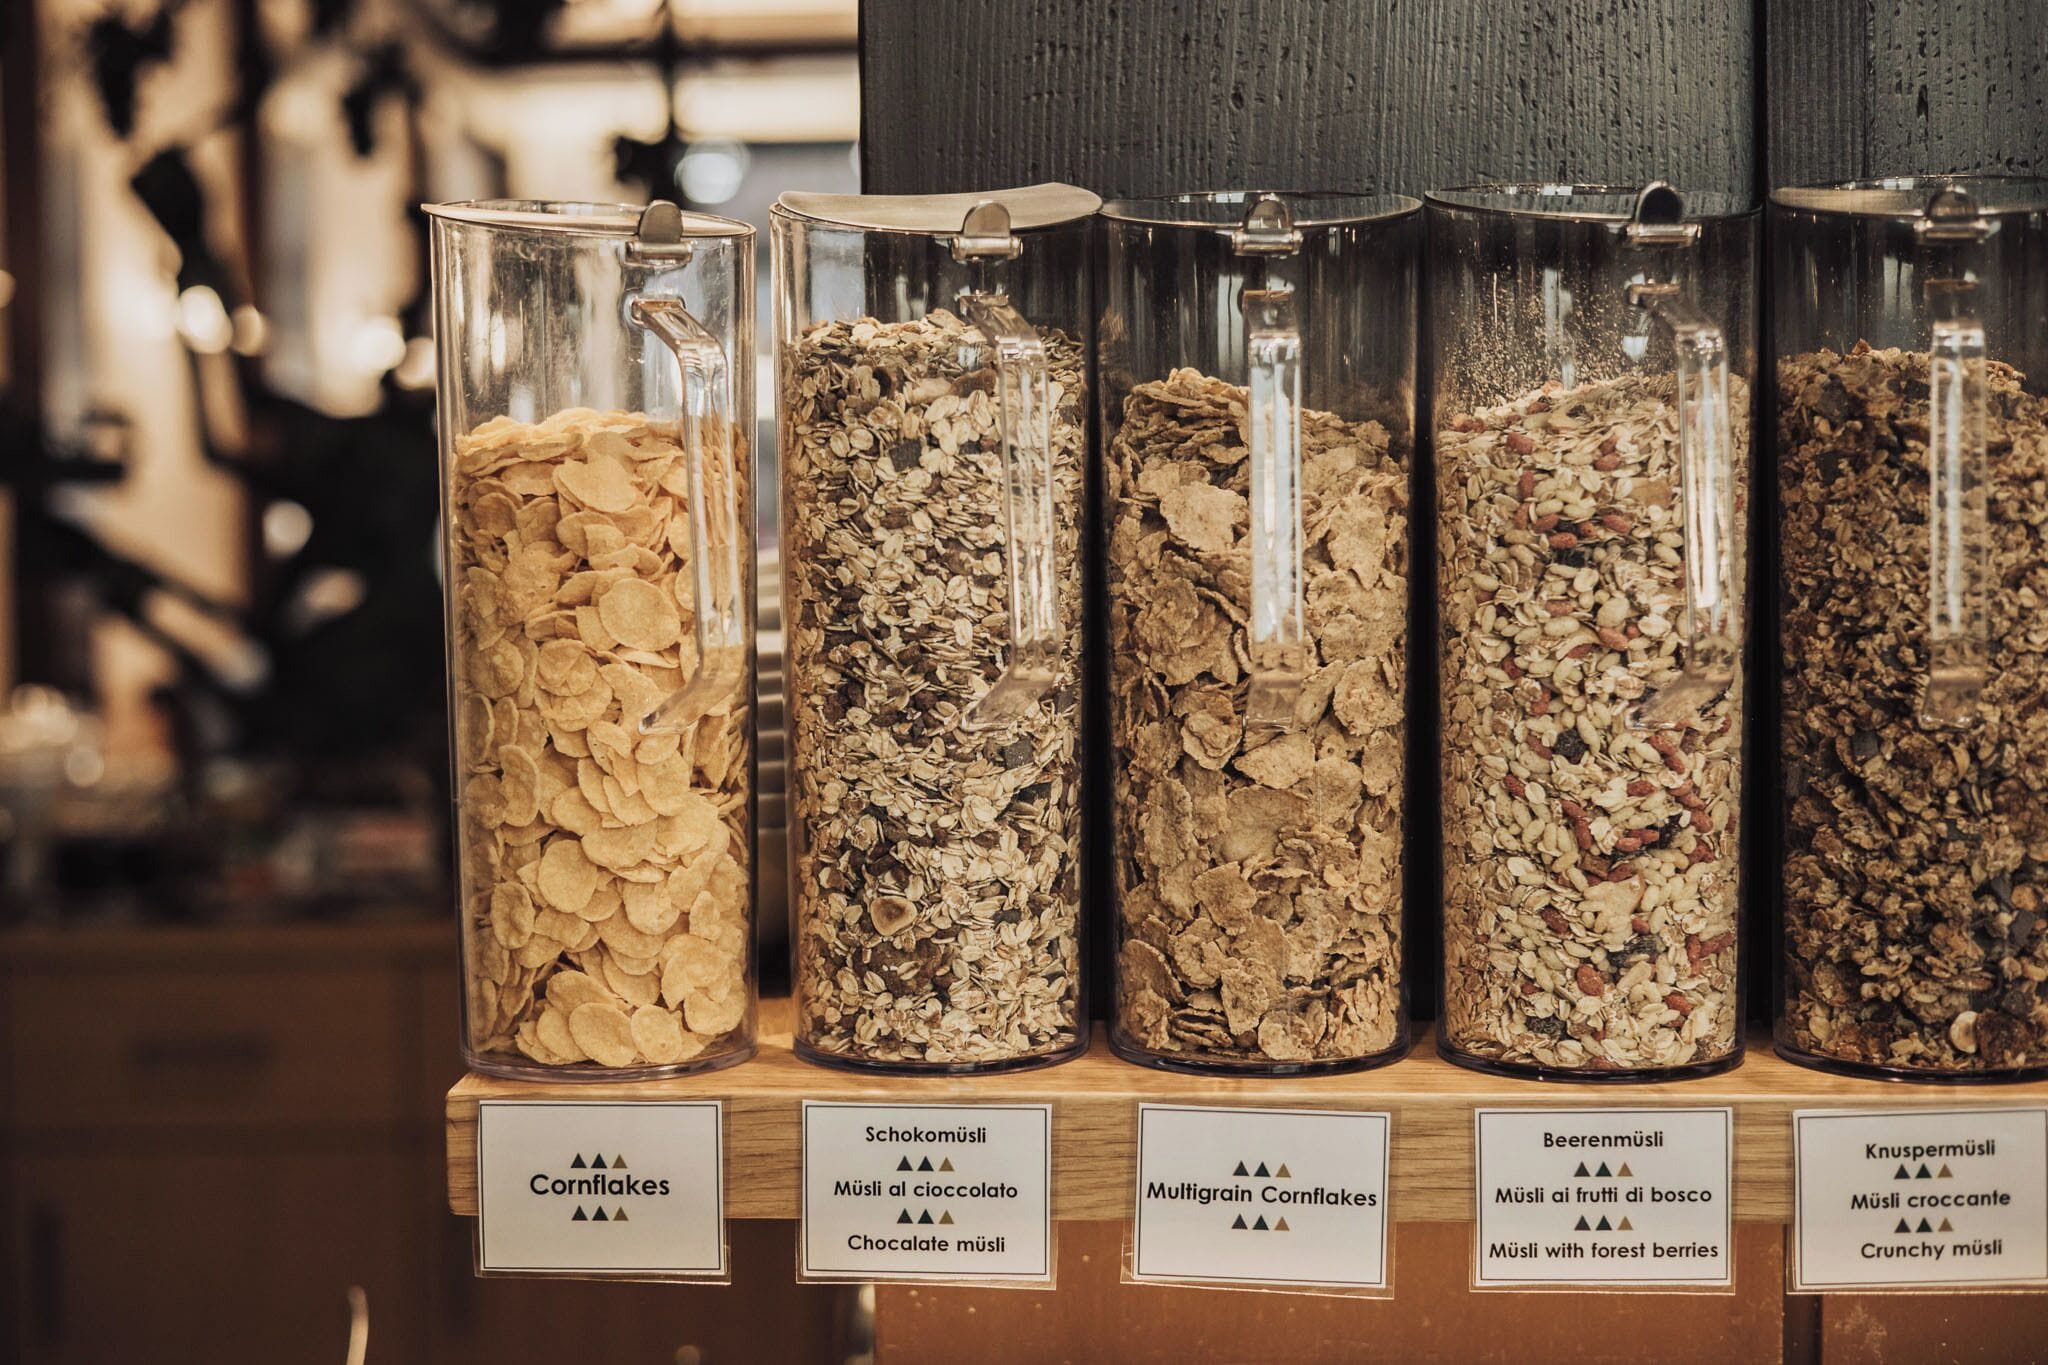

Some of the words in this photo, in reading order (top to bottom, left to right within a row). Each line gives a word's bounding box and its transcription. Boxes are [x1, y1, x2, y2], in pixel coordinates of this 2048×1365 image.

[865, 1126, 986, 1143] Schokomüsli
[1543, 1131, 1664, 1148] Beerenmüsli
[1865, 1140, 1996, 1162] Knuspermüsli
[529, 1173, 670, 1196] Cornflakes
[833, 1180, 882, 1196] Müsli
[888, 1181, 906, 1197] al
[913, 1182, 1018, 1199] cioccolato
[1146, 1181, 1253, 1205] Multigrain
[1261, 1185, 1377, 1207] Cornflakes
[1495, 1187, 1544, 1204] Müsli
[1551, 1187, 1569, 1204] ai
[1576, 1186, 1618, 1203] frutti
[1625, 1186, 1644, 1203] di
[1651, 1186, 1712, 1203] bosco
[1850, 1192, 1900, 1210] Müsli
[1907, 1190, 2011, 1209] croccante
[847, 1234, 949, 1252] Chocalate
[956, 1236, 1005, 1253] müsli
[1489, 1242, 1538, 1259] Müsli
[1545, 1242, 1584, 1259] with
[1591, 1242, 1646, 1258] forest
[1652, 1242, 1719, 1258] berries
[1860, 1241, 1945, 1261] Crunchy
[1952, 1239, 2003, 1257] müsli
